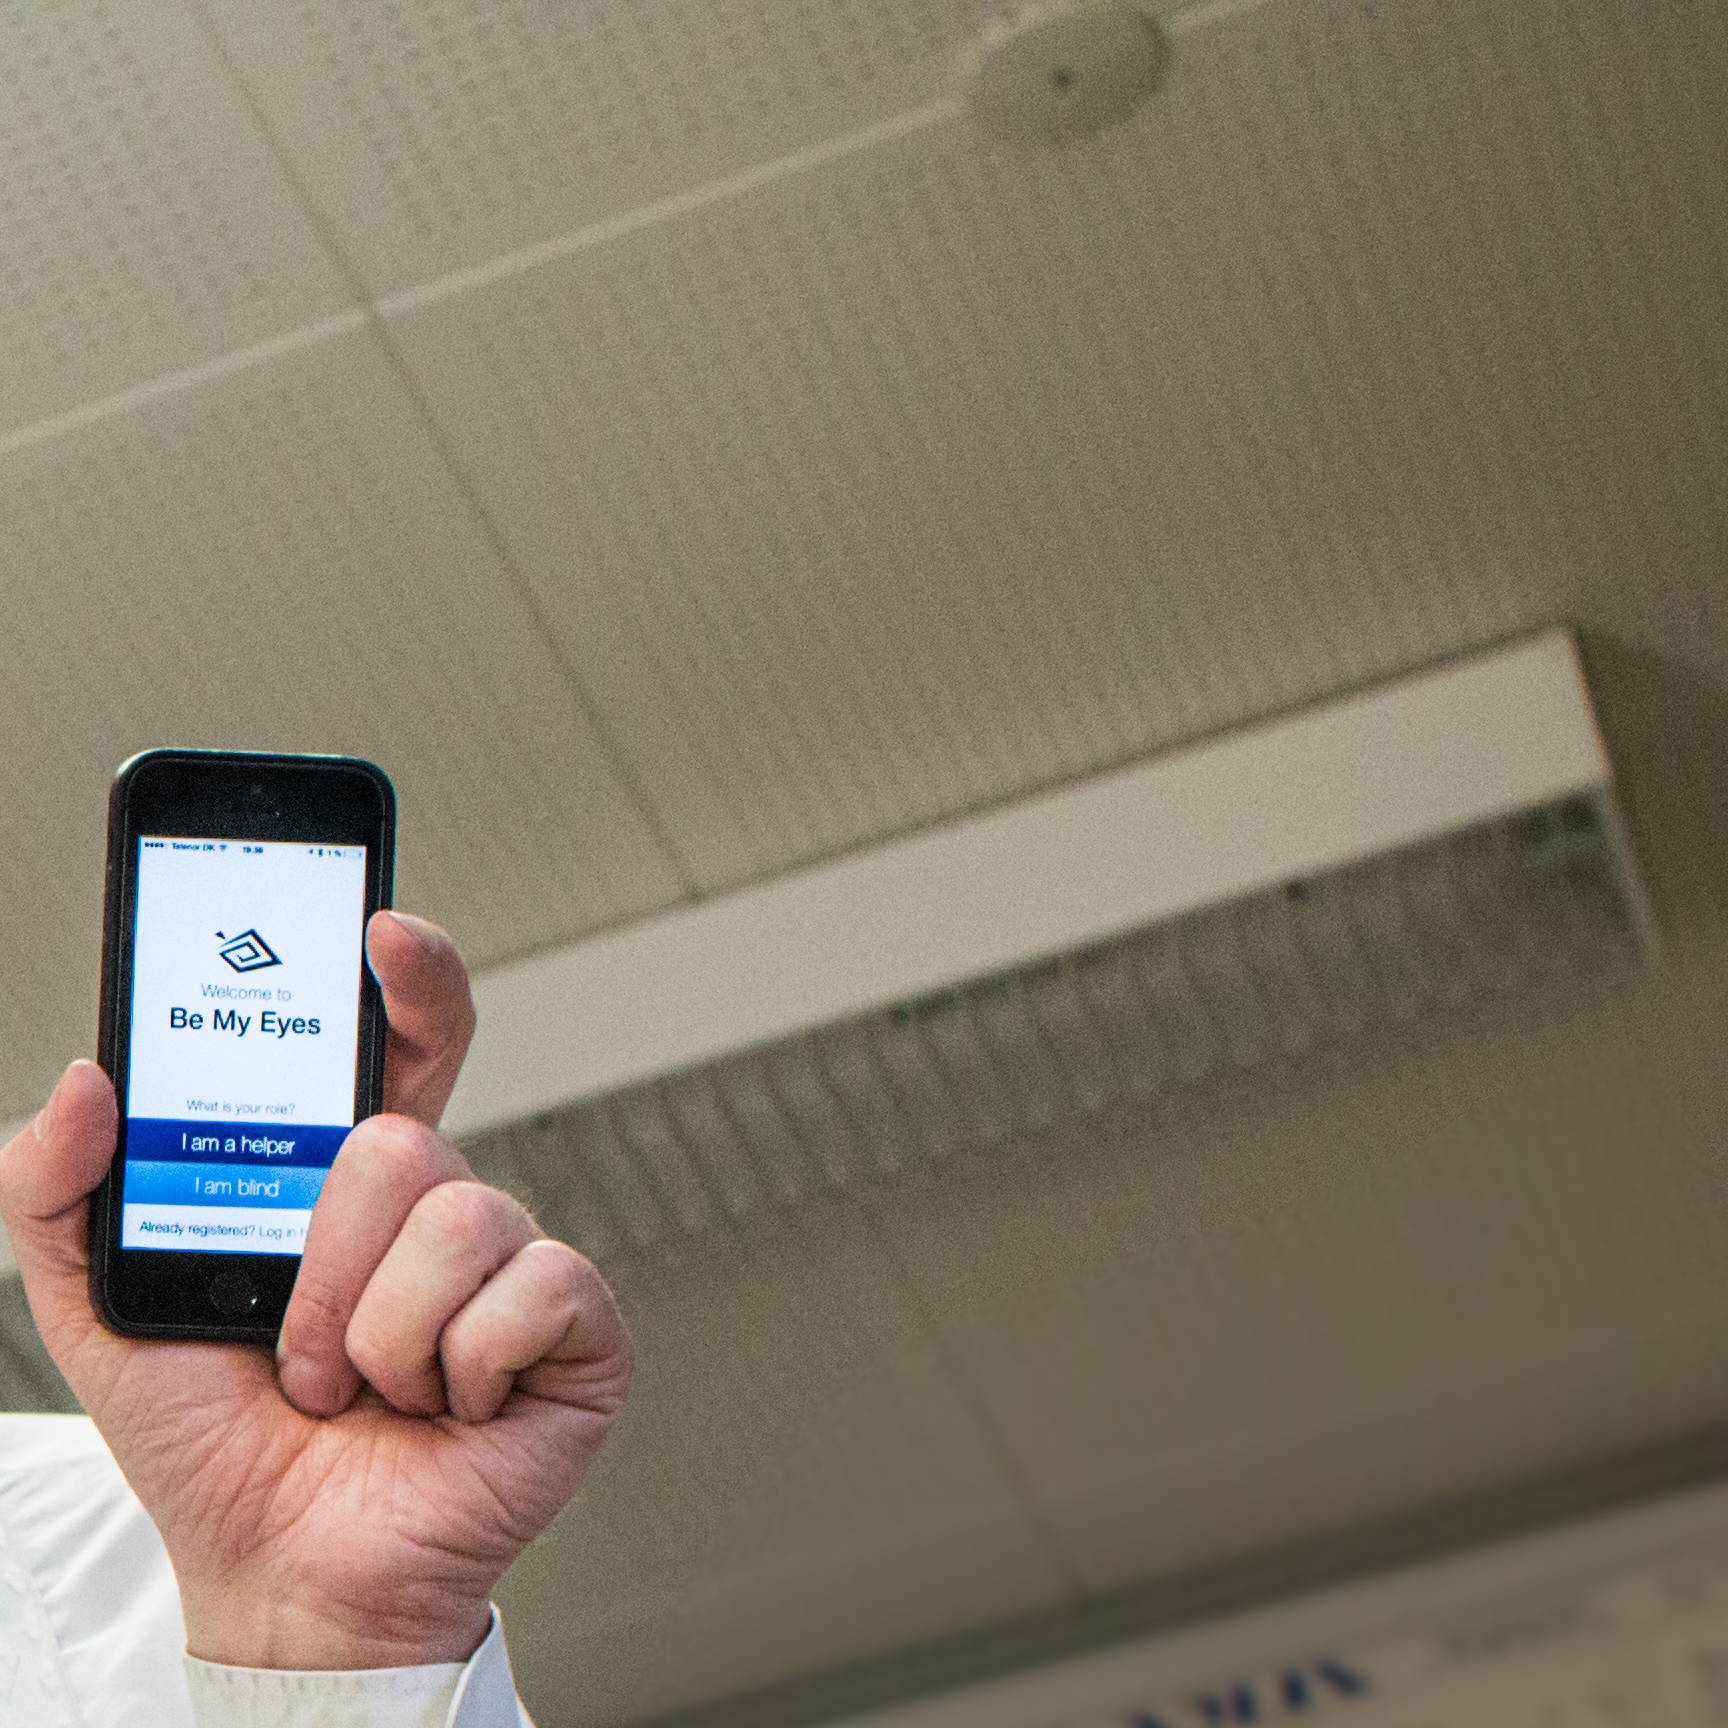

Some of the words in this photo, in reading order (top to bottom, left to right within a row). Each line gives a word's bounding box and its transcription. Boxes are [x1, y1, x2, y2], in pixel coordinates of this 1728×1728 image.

[200, 982, 272, 1001] Welcome
[277, 987, 292, 1001] to
[170, 1006, 204, 1030] Be
[213, 1008, 252, 1038] My
[260, 1010, 322, 1039] Eyes
[186, 1099, 219, 1112] What
[222, 1101, 232, 1113] is
[234, 1103, 262, 1115] your
[264, 1102, 296, 1115] role?
[182, 1132, 187, 1151] I
[190, 1136, 220, 1152] am
[224, 1138, 236, 1153] a
[241, 1135, 296, 1158] helper
[204, 1180, 232, 1196] am
[237, 1178, 280, 1198] blind
[140, 1220, 184, 1236] Already
[188, 1224, 255, 1238] registered?
[258, 1226, 282, 1240] Log
[286, 1228, 296, 1238] in
